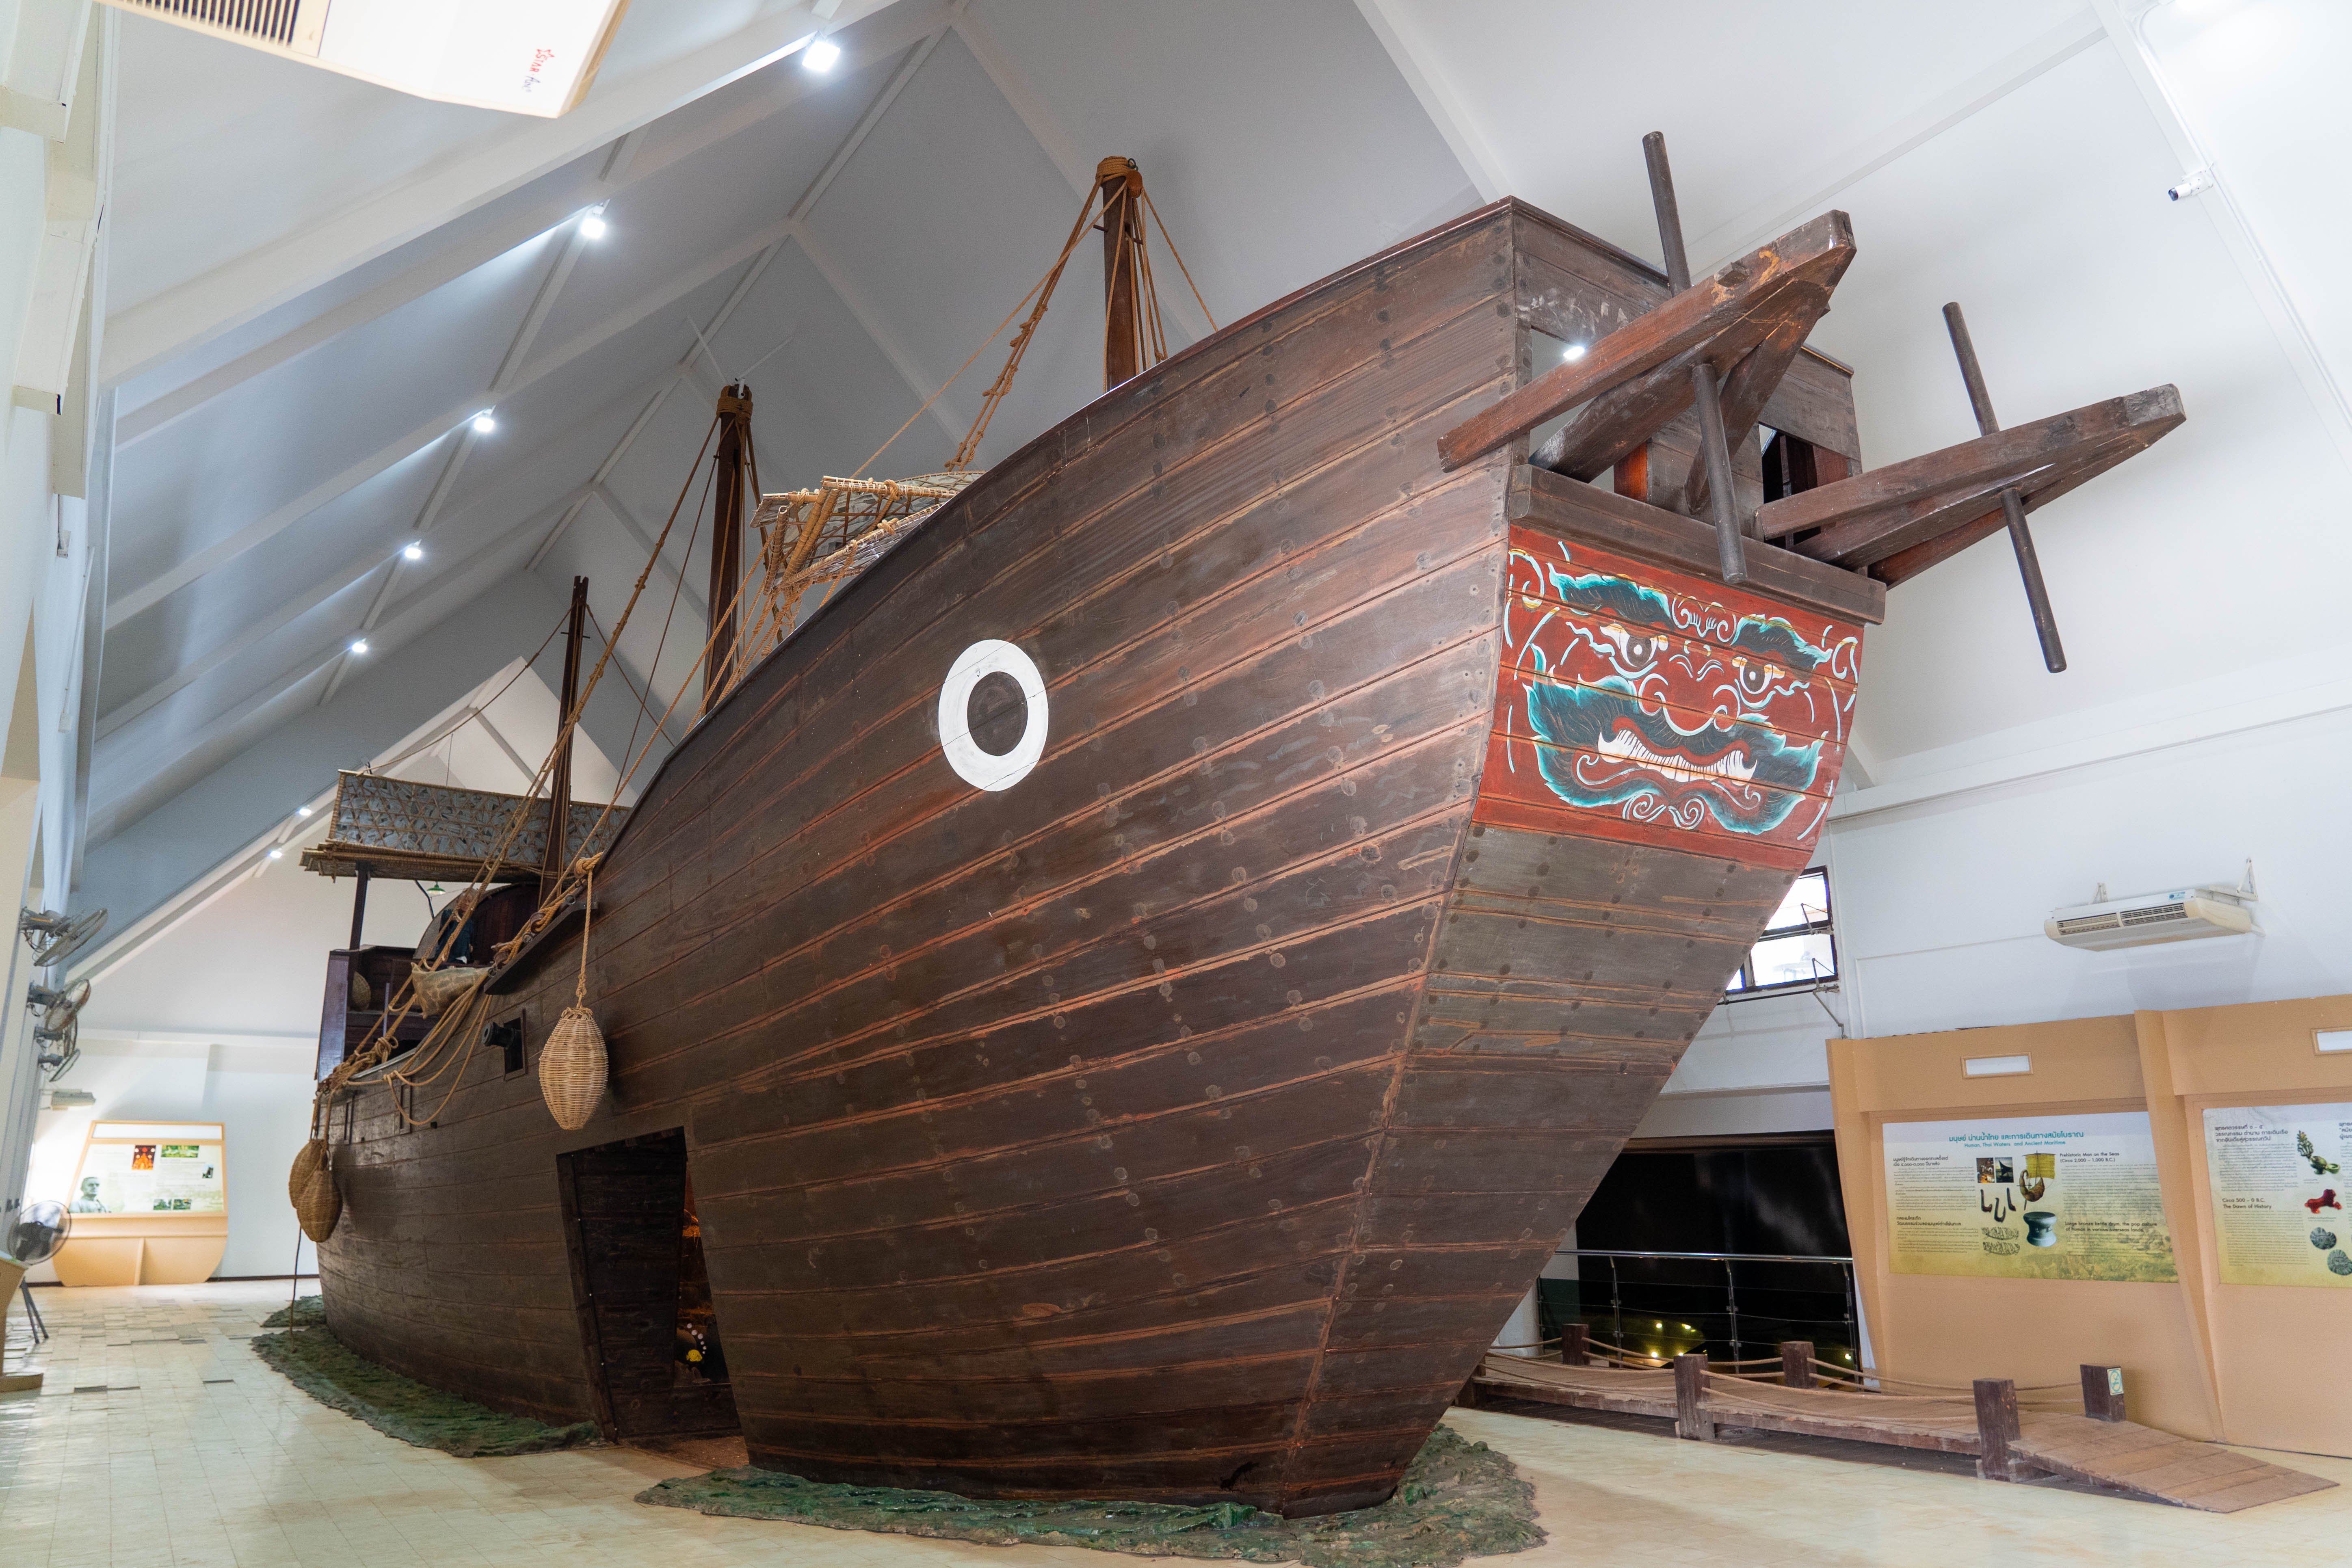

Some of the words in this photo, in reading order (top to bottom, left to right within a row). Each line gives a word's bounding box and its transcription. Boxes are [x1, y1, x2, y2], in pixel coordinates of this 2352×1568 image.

[1949, 1134, 1966, 1143] มนุษย์
[1968, 1132, 1999, 1141] น่านน้ำไทย
[2001, 1131, 2084, 1140] และการเดินทางสมัยโบราณ
